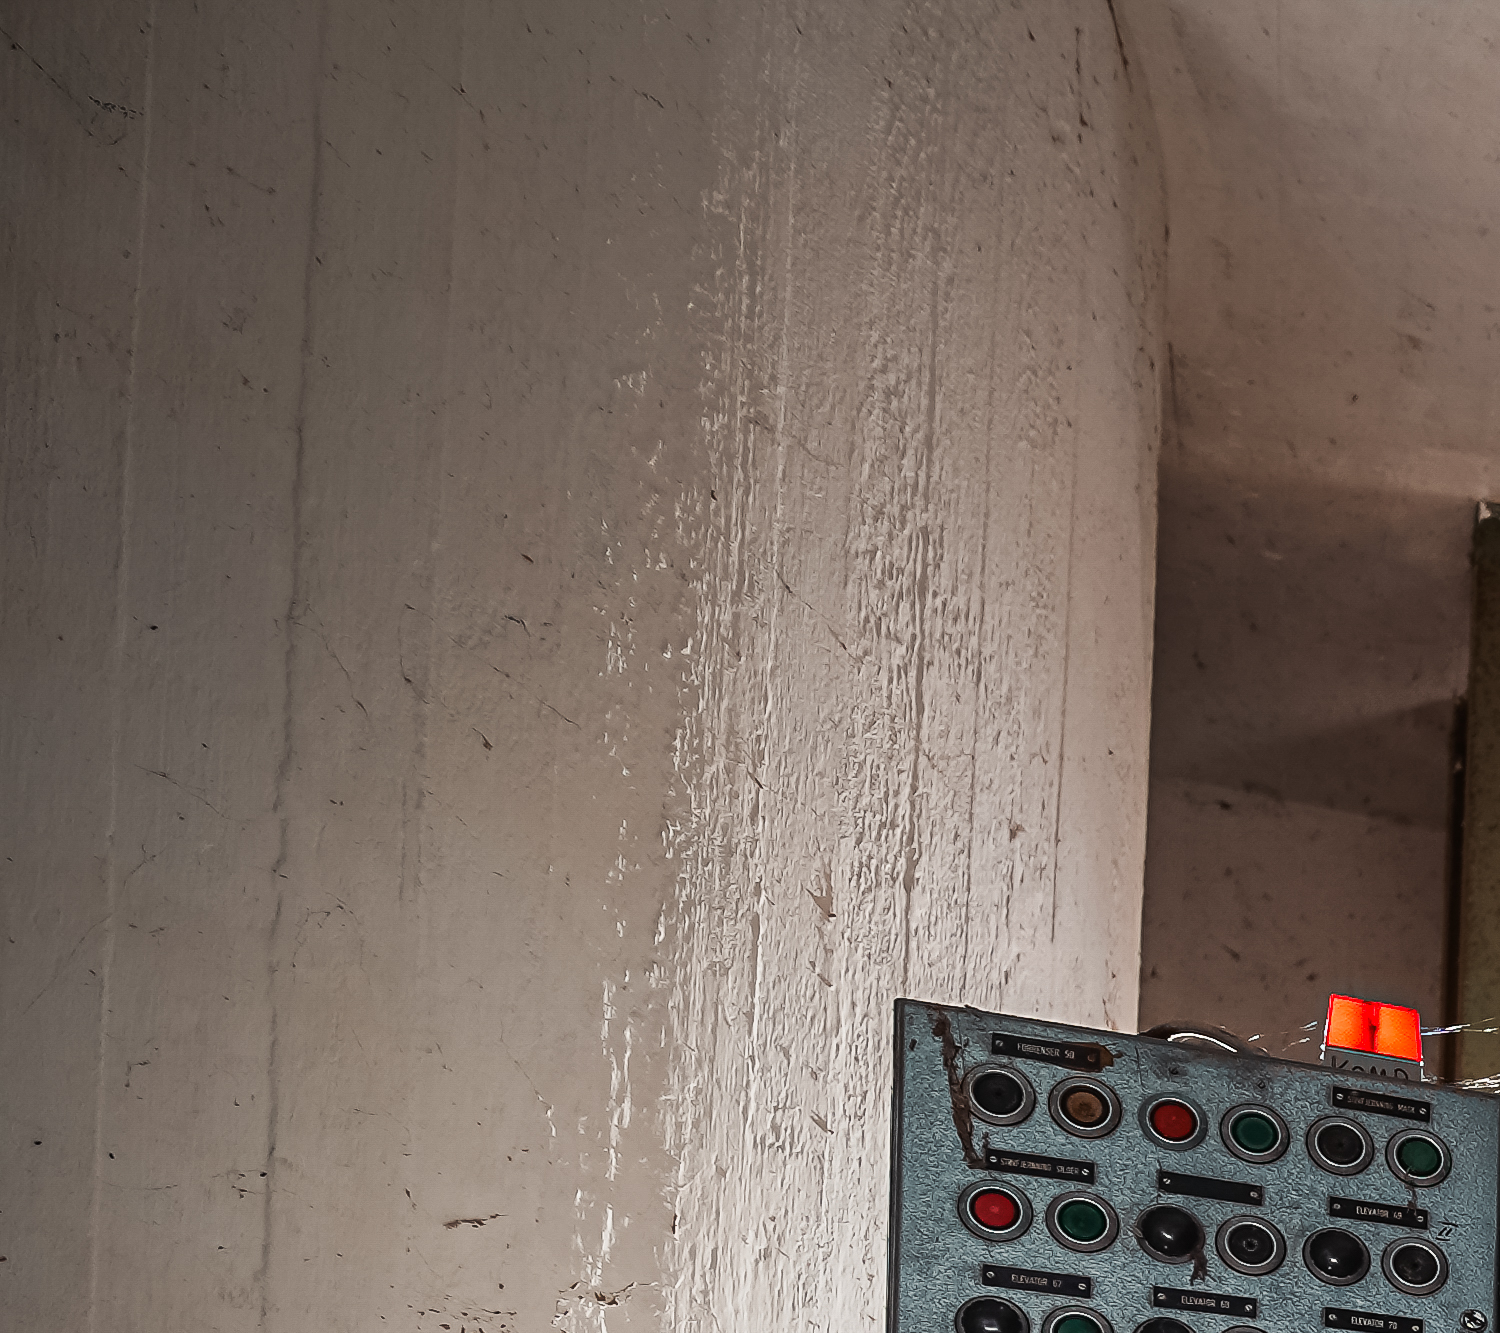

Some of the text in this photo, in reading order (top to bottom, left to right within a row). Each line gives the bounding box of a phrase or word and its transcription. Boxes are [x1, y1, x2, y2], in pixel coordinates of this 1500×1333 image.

[1355, 1205, 1390, 1219] ELEVATOR
[1010, 1273, 1048, 1286] ELEVATOR
[1181, 1295, 1216, 1308] ELEVATOR
[1351, 1316, 1385, 1328] ELEVATOR
